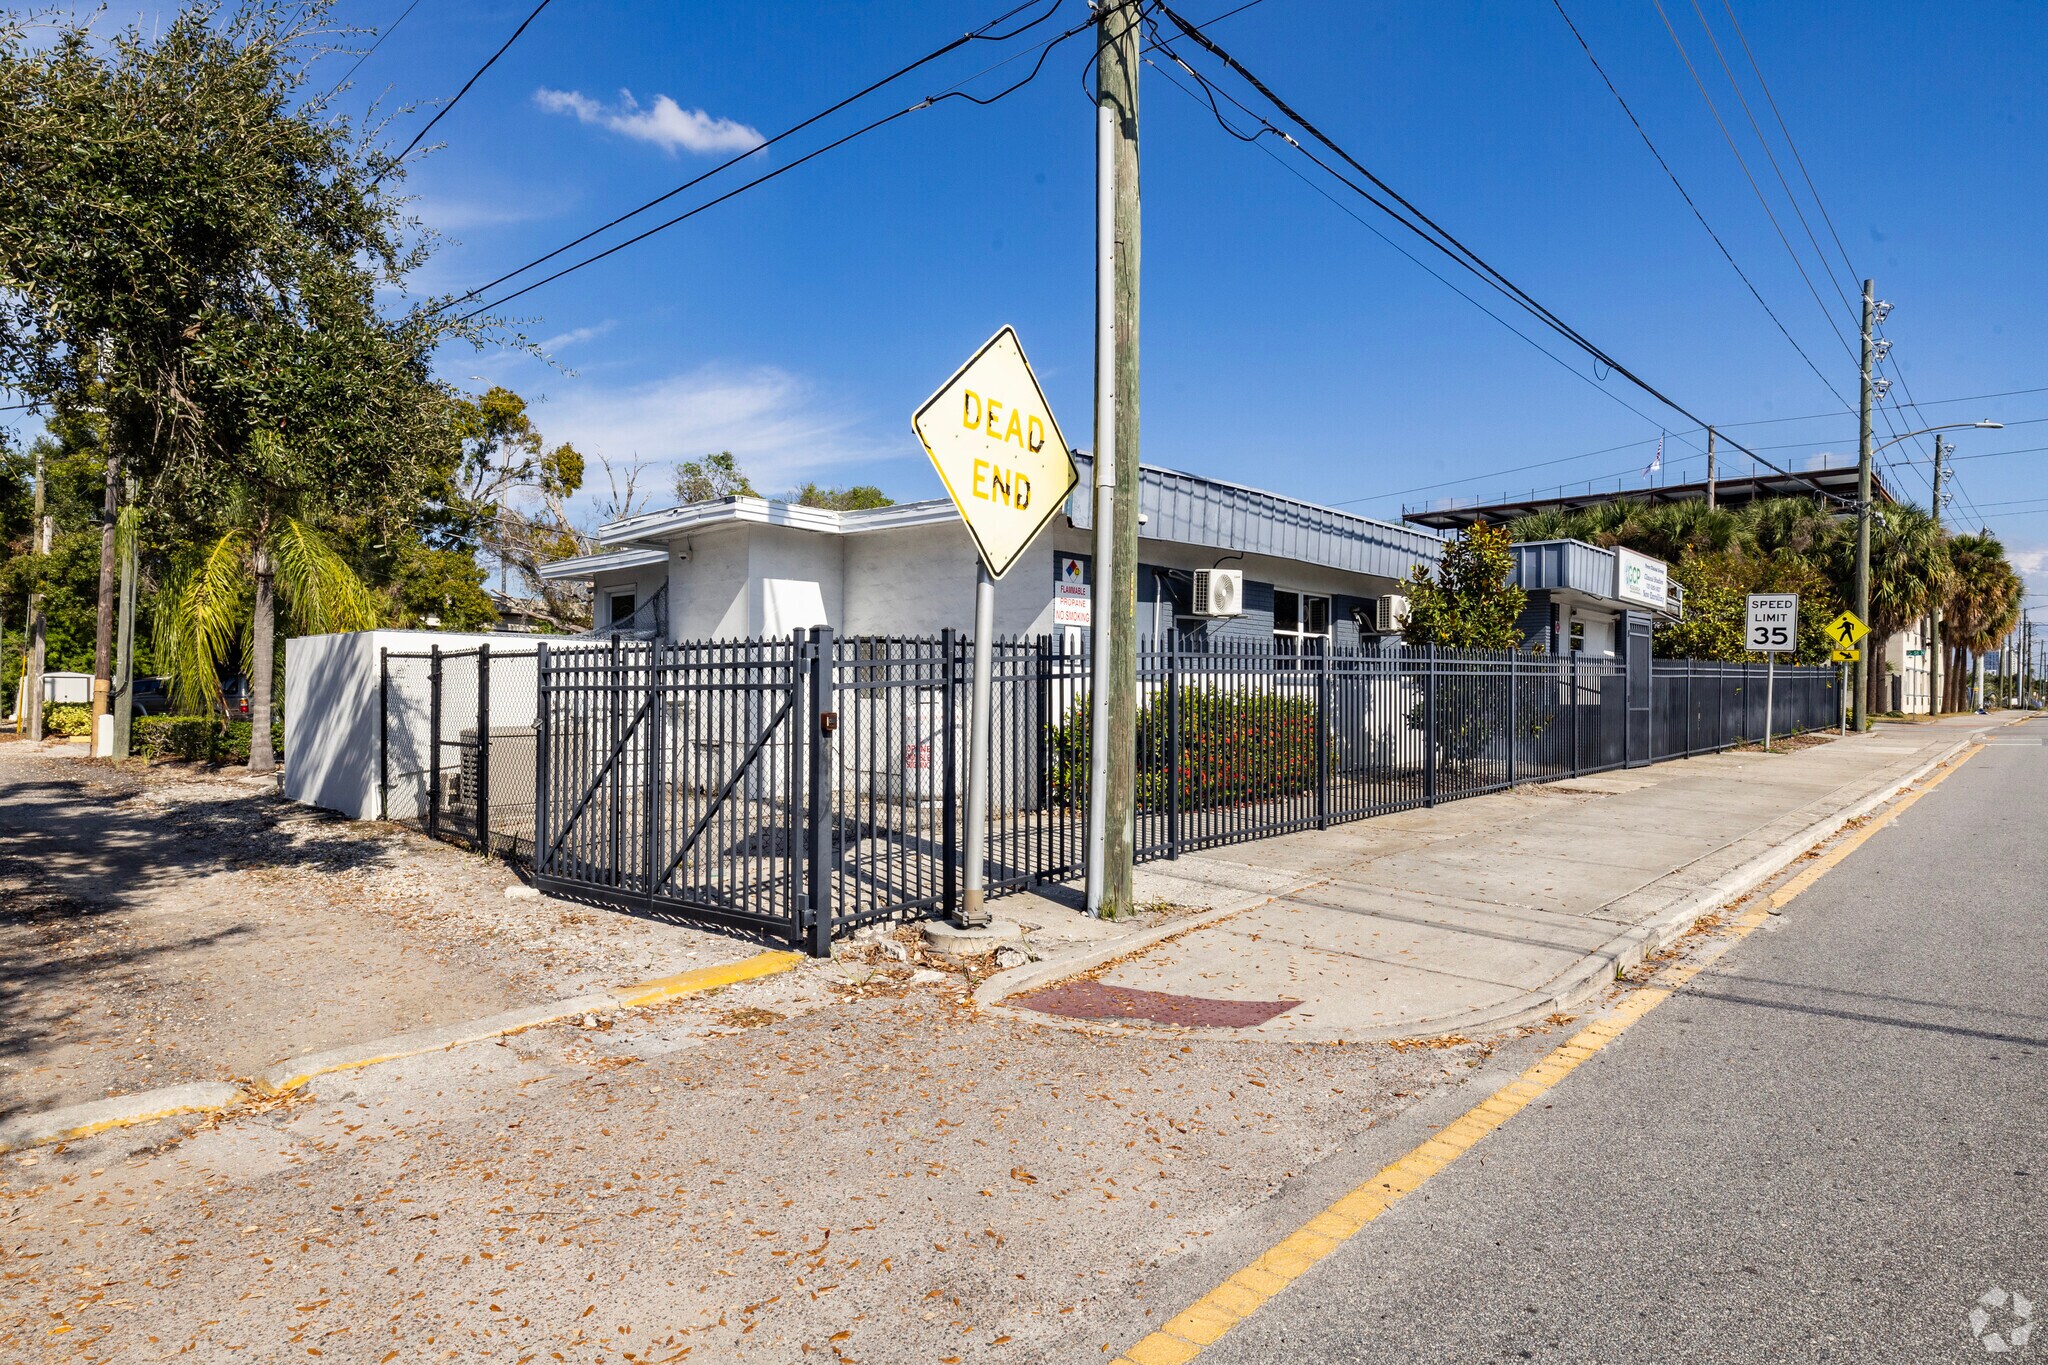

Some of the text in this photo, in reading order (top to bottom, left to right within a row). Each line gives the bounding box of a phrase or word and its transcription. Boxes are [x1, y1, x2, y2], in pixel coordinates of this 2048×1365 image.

[963, 388, 1045, 454] DEAD
[972, 458, 1031, 511] END
[1629, 566, 1641, 584] GCP
[1060, 585, 1086, 596] FLAMMABLE
[1060, 597, 1086, 608] PROPANE
[1751, 600, 1793, 609] SPEED
[1056, 610, 1090, 623] NO SMOKING
[1755, 613, 1788, 622] LIMIT
[1752, 627, 1788, 645] 35
